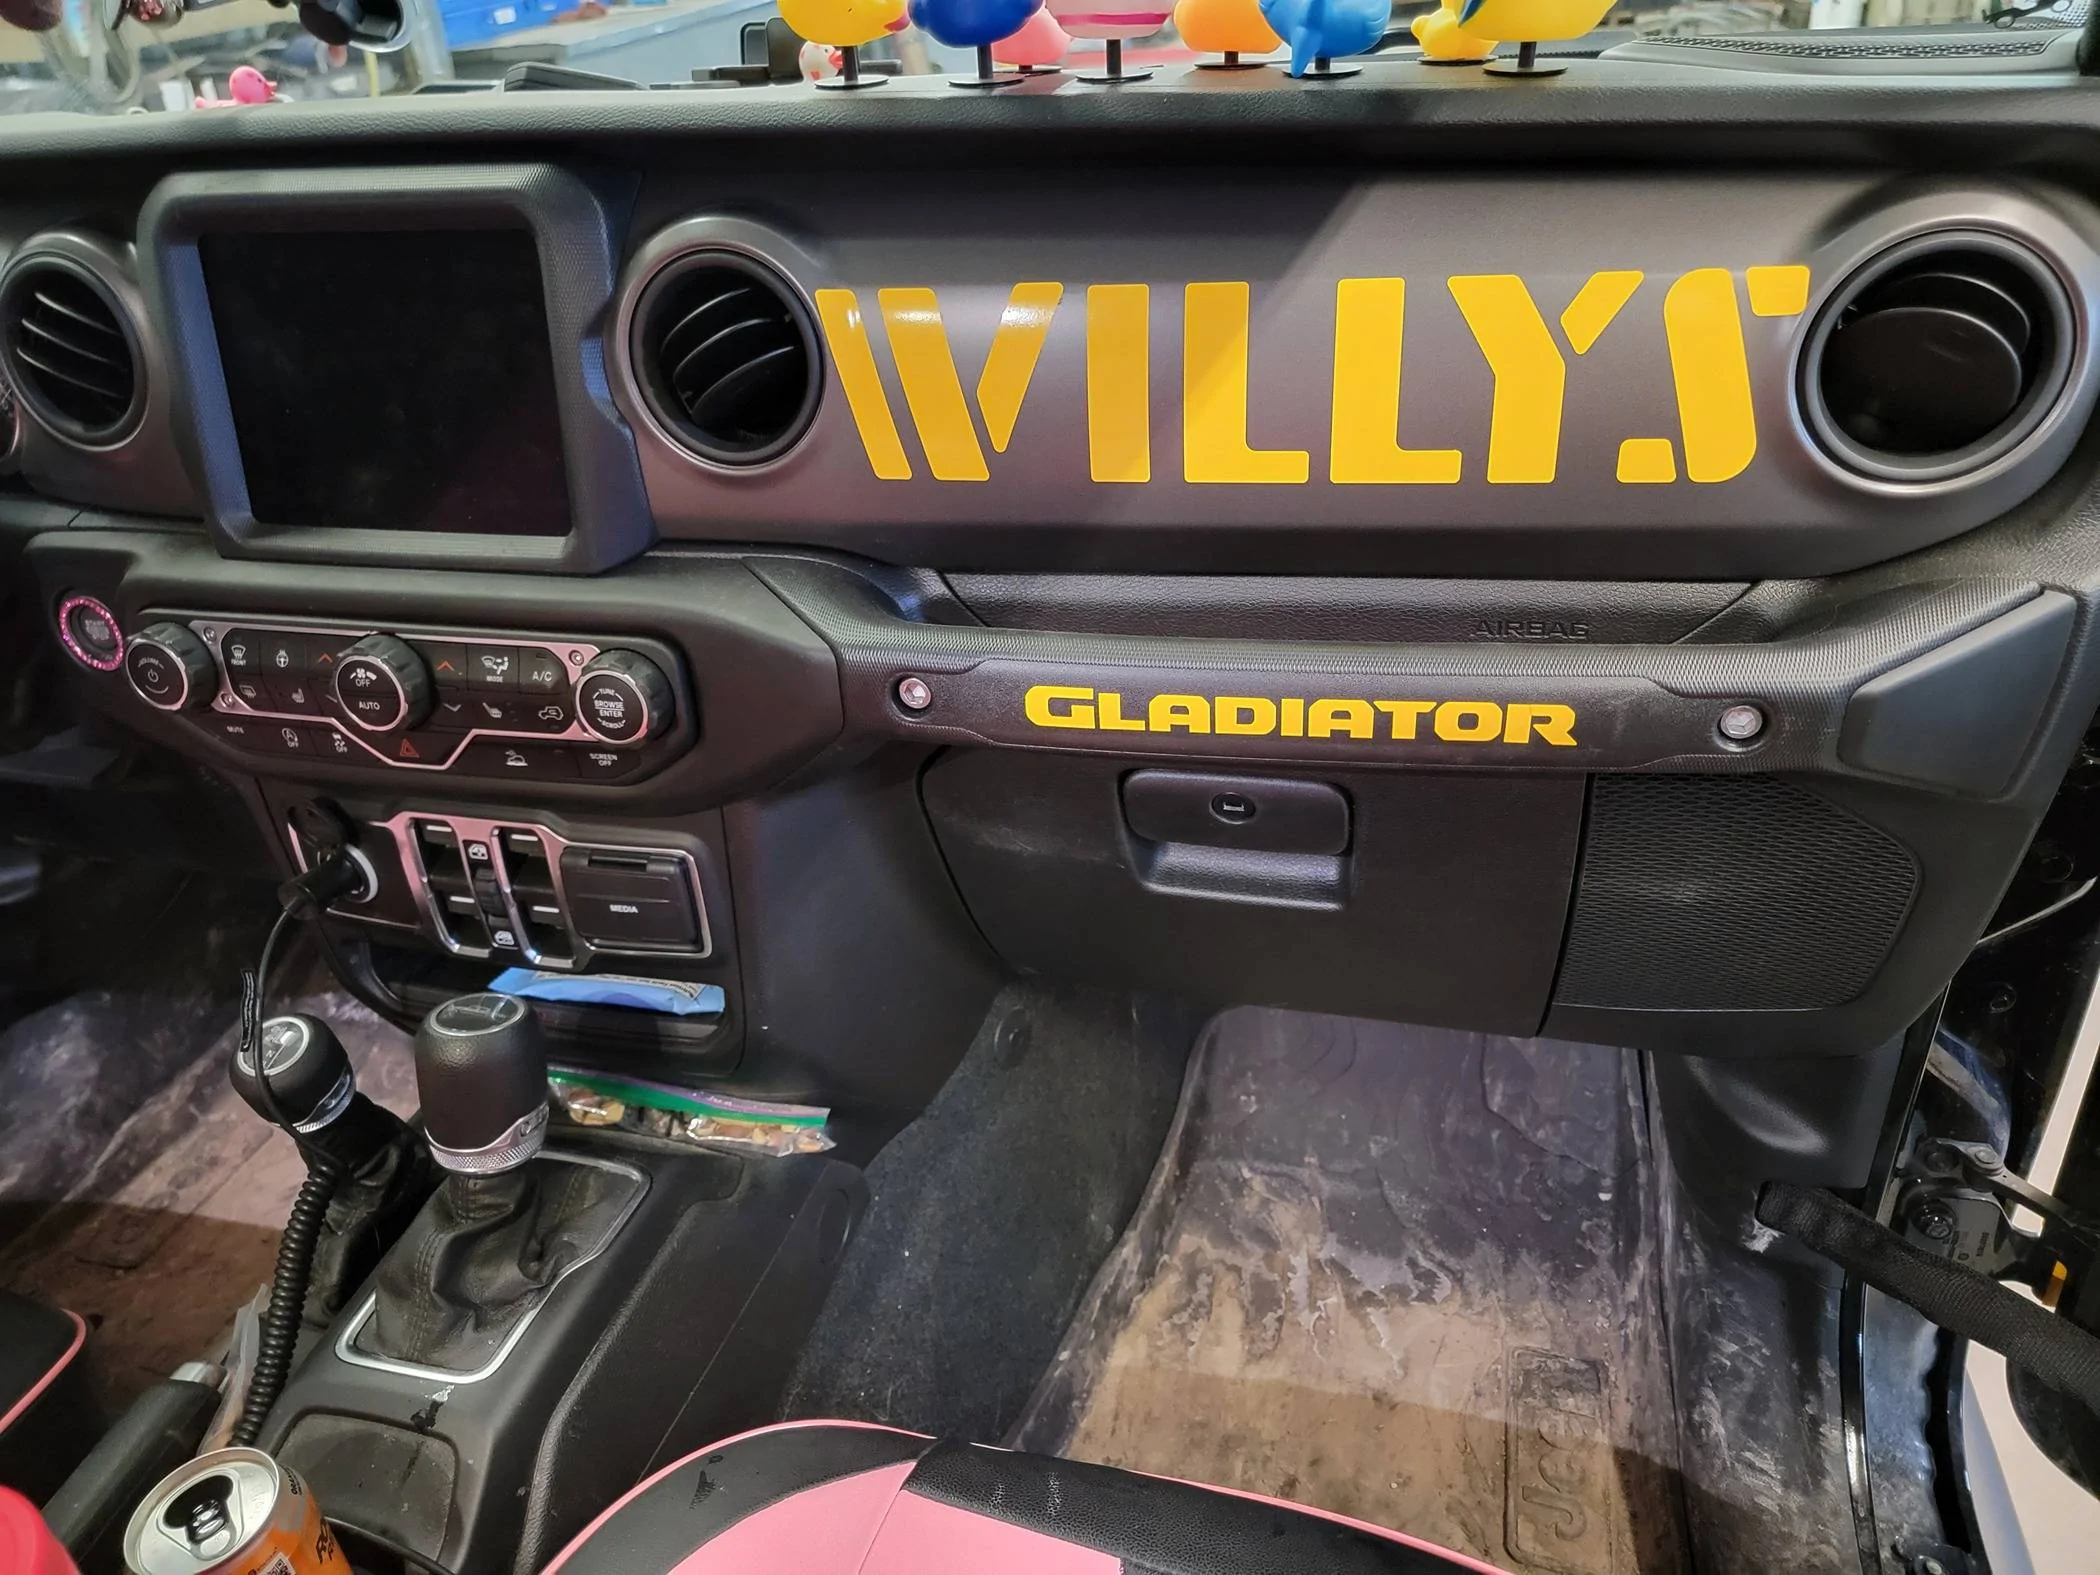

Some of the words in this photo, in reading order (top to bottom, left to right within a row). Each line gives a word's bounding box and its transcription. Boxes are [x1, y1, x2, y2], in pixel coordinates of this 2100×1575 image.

[813, 263, 1813, 485] WILLYS
[1470, 618, 1590, 641] AIRBAG
[485, 675, 504, 683] MODE
[532, 670, 552, 682] A/C
[355, 679, 371, 687] OFF
[598, 688, 616, 696] TUNE
[358, 701, 381, 711] AUTO
[593, 699, 624, 710] BROWSE
[598, 709, 623, 718] ENTER
[1023, 683, 1579, 747] GLADIATOR
[588, 752, 618, 761] SCREEN
[597, 759, 612, 767] OFF
[609, 904, 640, 914] MEDIA
